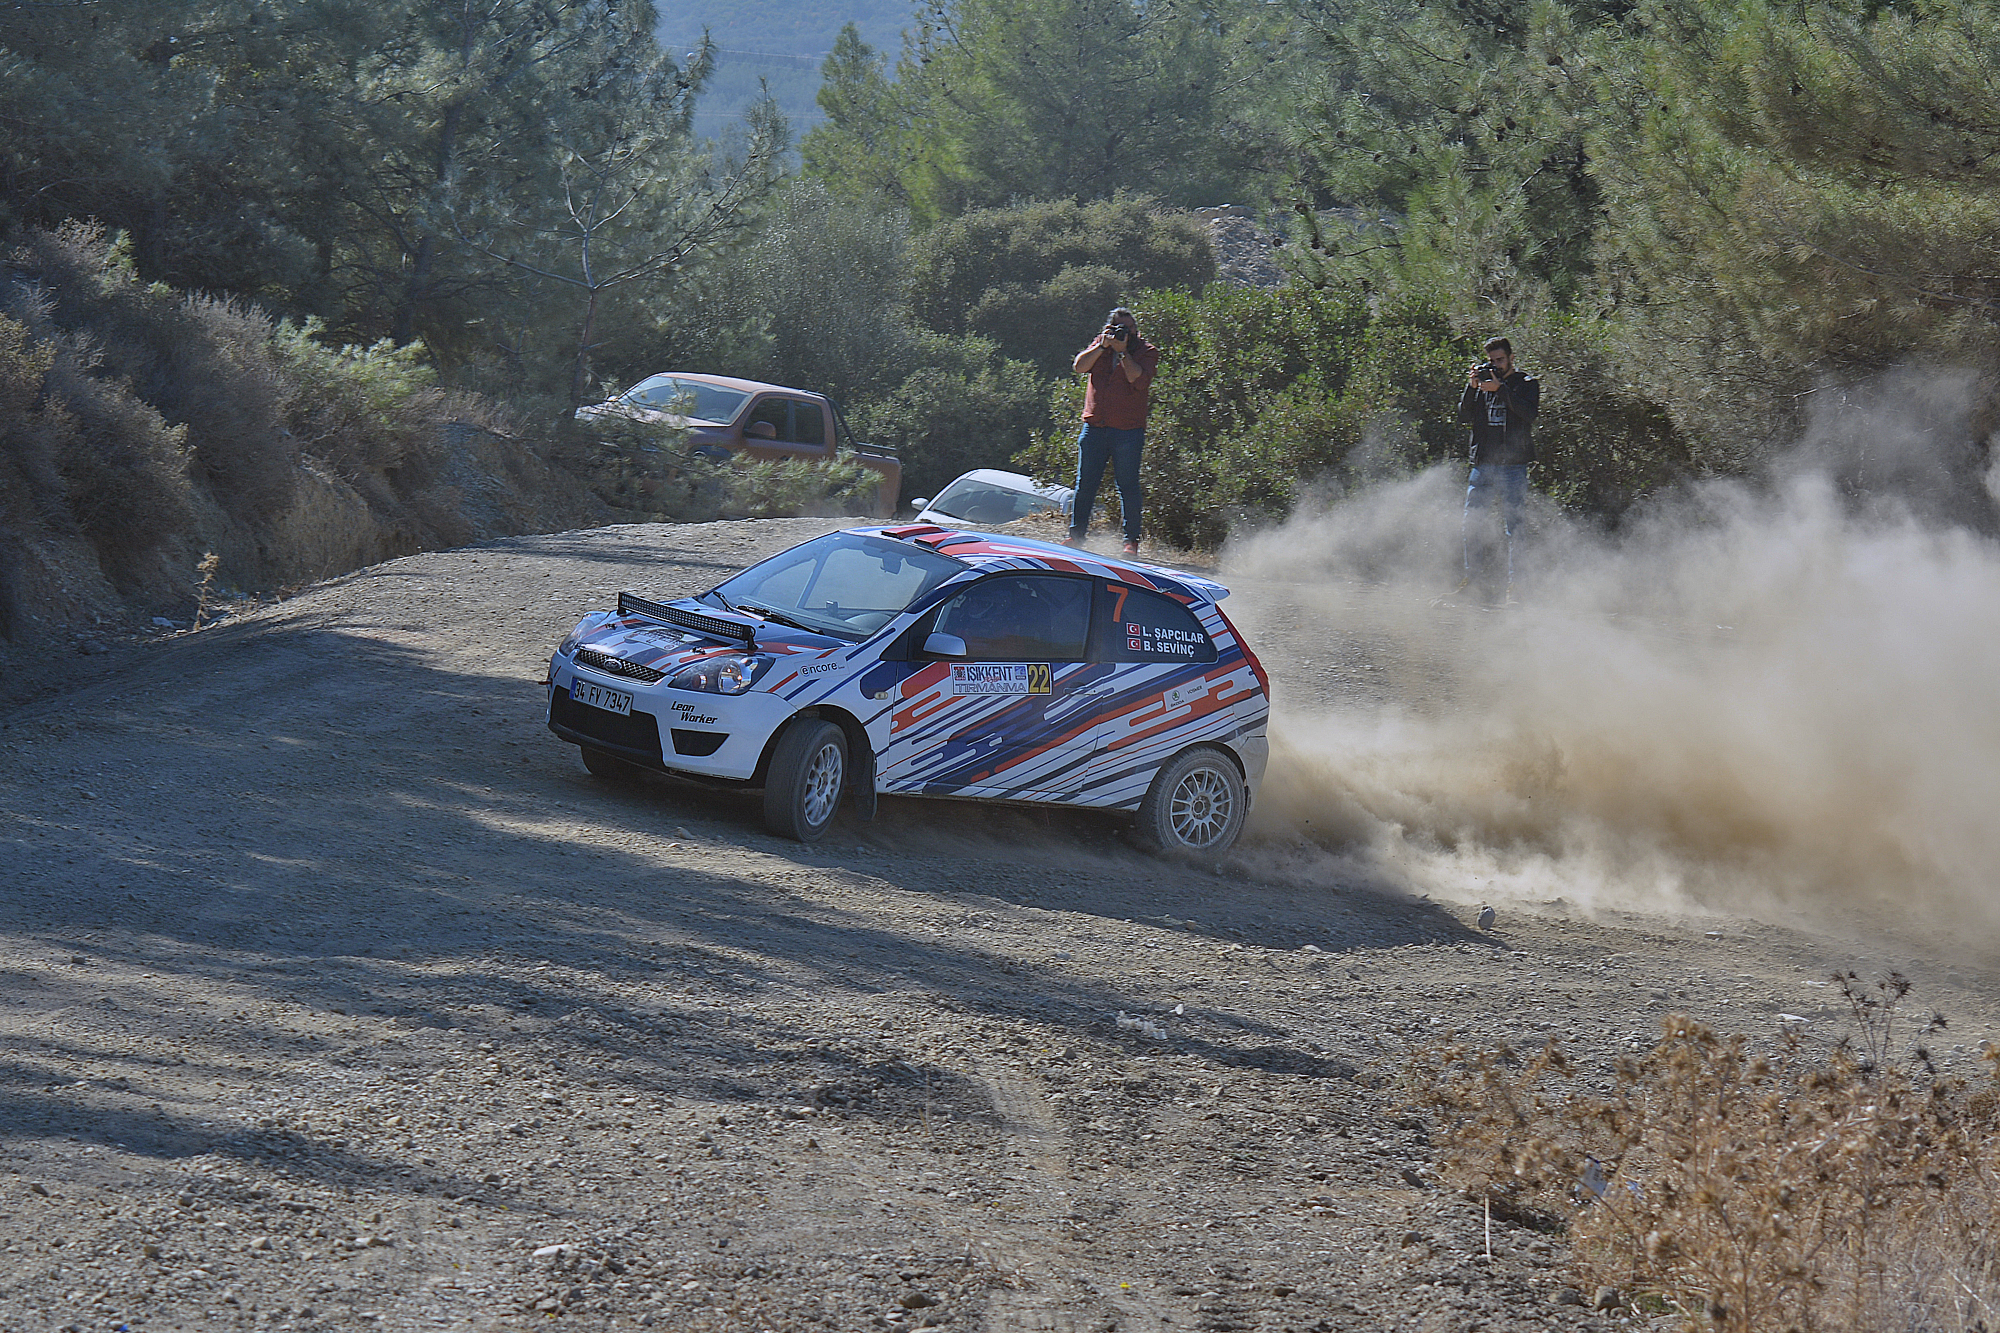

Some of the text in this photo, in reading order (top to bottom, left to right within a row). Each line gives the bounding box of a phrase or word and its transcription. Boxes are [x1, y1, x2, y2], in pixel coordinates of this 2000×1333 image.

[1107, 584, 1128, 622] 7
[1142, 626, 1204, 644] L. ŞAPCILAR
[1143, 640, 1195, 657] B. SEVİNÇ
[966, 666, 1013, 682] IŞIKKENT
[1028, 665, 1050, 693] 22
[574, 680, 585, 699] 34
[603, 690, 630, 711] 7347
[955, 683, 1026, 692] TIRMANMA
[671, 700, 695, 712] Leon
[680, 711, 718, 724] Worker
